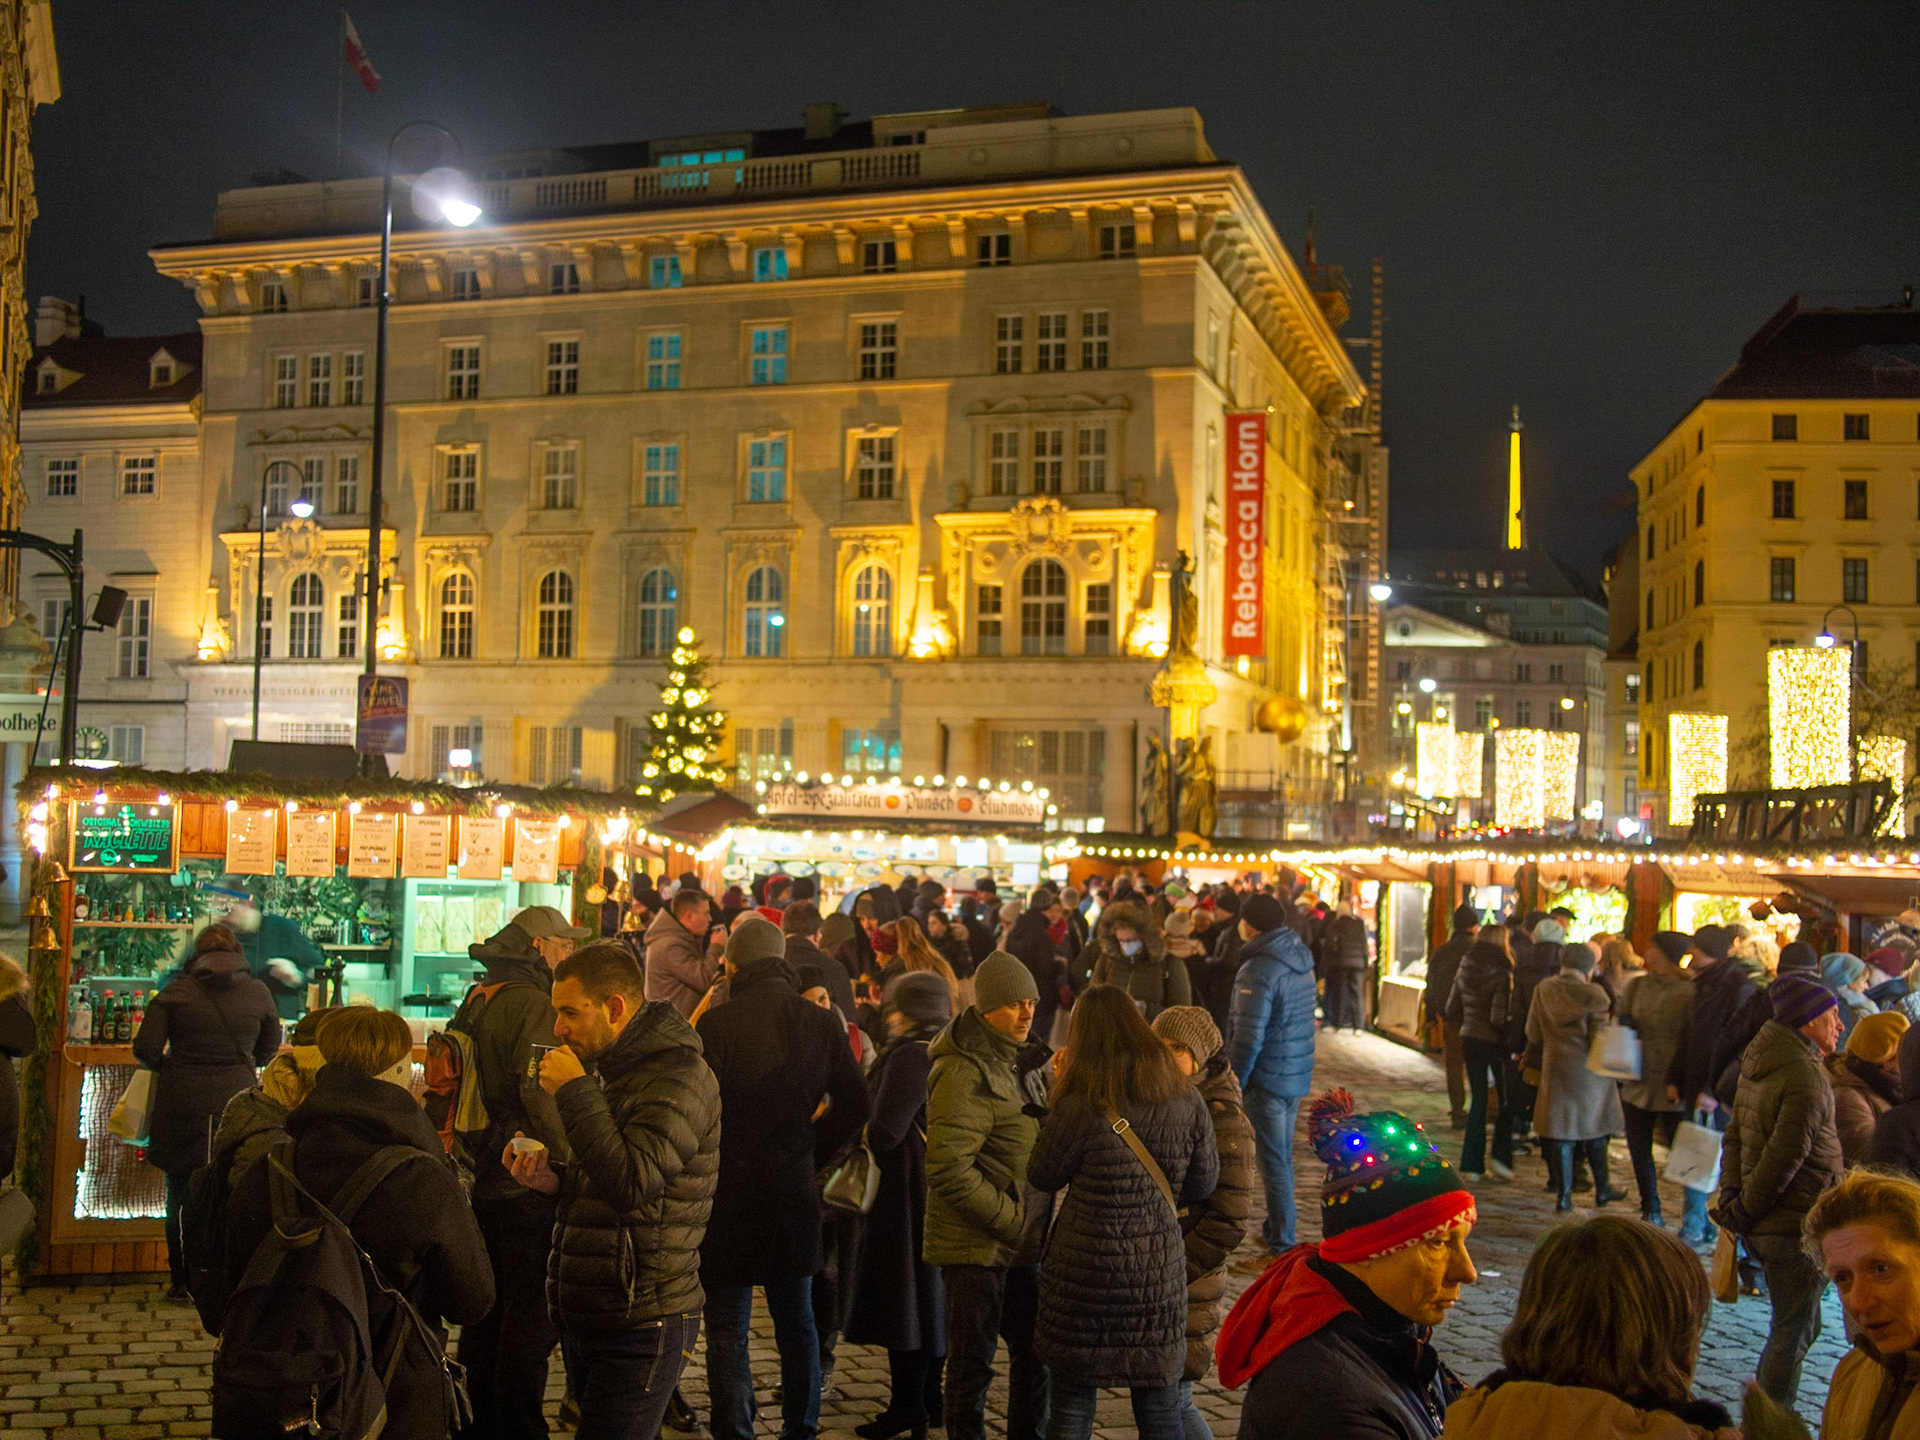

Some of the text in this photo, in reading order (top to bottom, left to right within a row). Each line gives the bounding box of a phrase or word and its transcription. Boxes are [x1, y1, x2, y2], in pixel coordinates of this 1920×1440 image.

[1232, 421, 1259, 638] Rebecca Horn
[0, 712, 56, 731] otheke
[904, 792, 954, 812] Punsch
[82, 817, 171, 828] ORIGINAL CHWEIZER
[83, 827, 171, 850] RACLETTE
